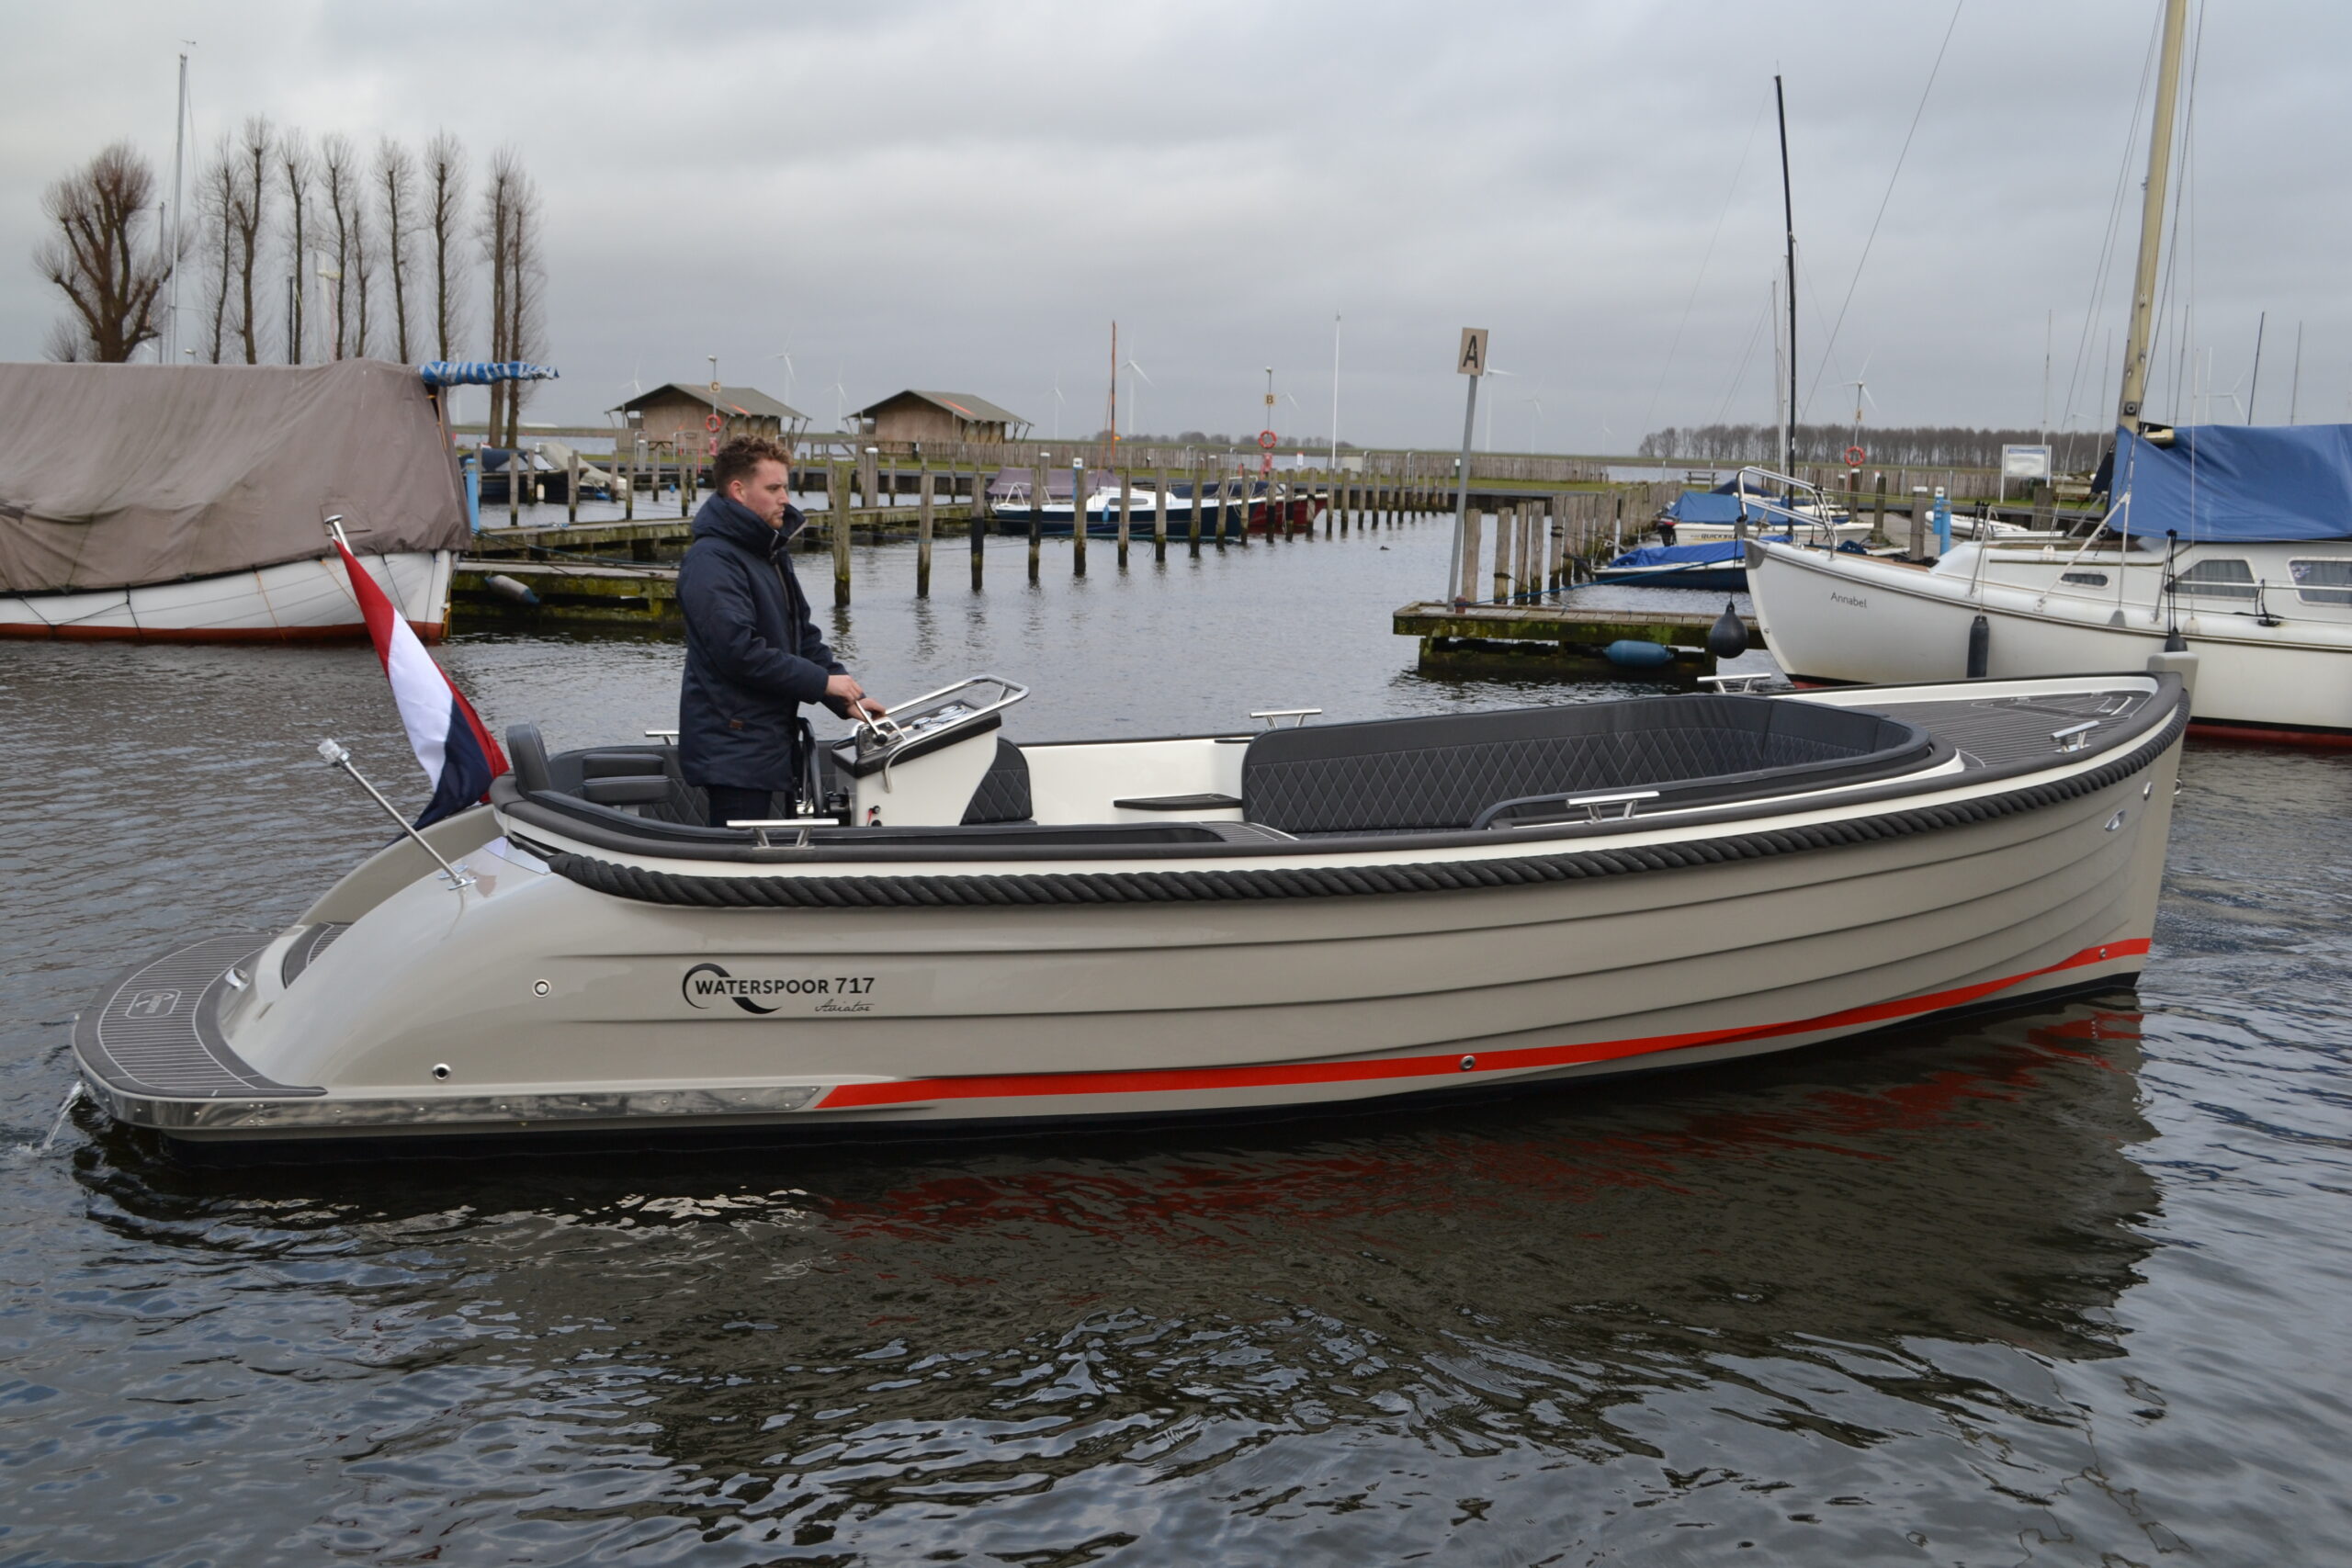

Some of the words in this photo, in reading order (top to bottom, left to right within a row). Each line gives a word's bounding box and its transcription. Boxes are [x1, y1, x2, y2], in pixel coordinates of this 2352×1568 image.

[1462, 334, 1478, 368] A
[711, 381, 719, 391] C
[1266, 394, 1273, 404] B
[1830, 592, 1868, 608] Annabel
[695, 979, 829, 995] WATERSPOOR
[835, 977, 875, 994] 717
[814, 998, 875, 1012] Aviator
